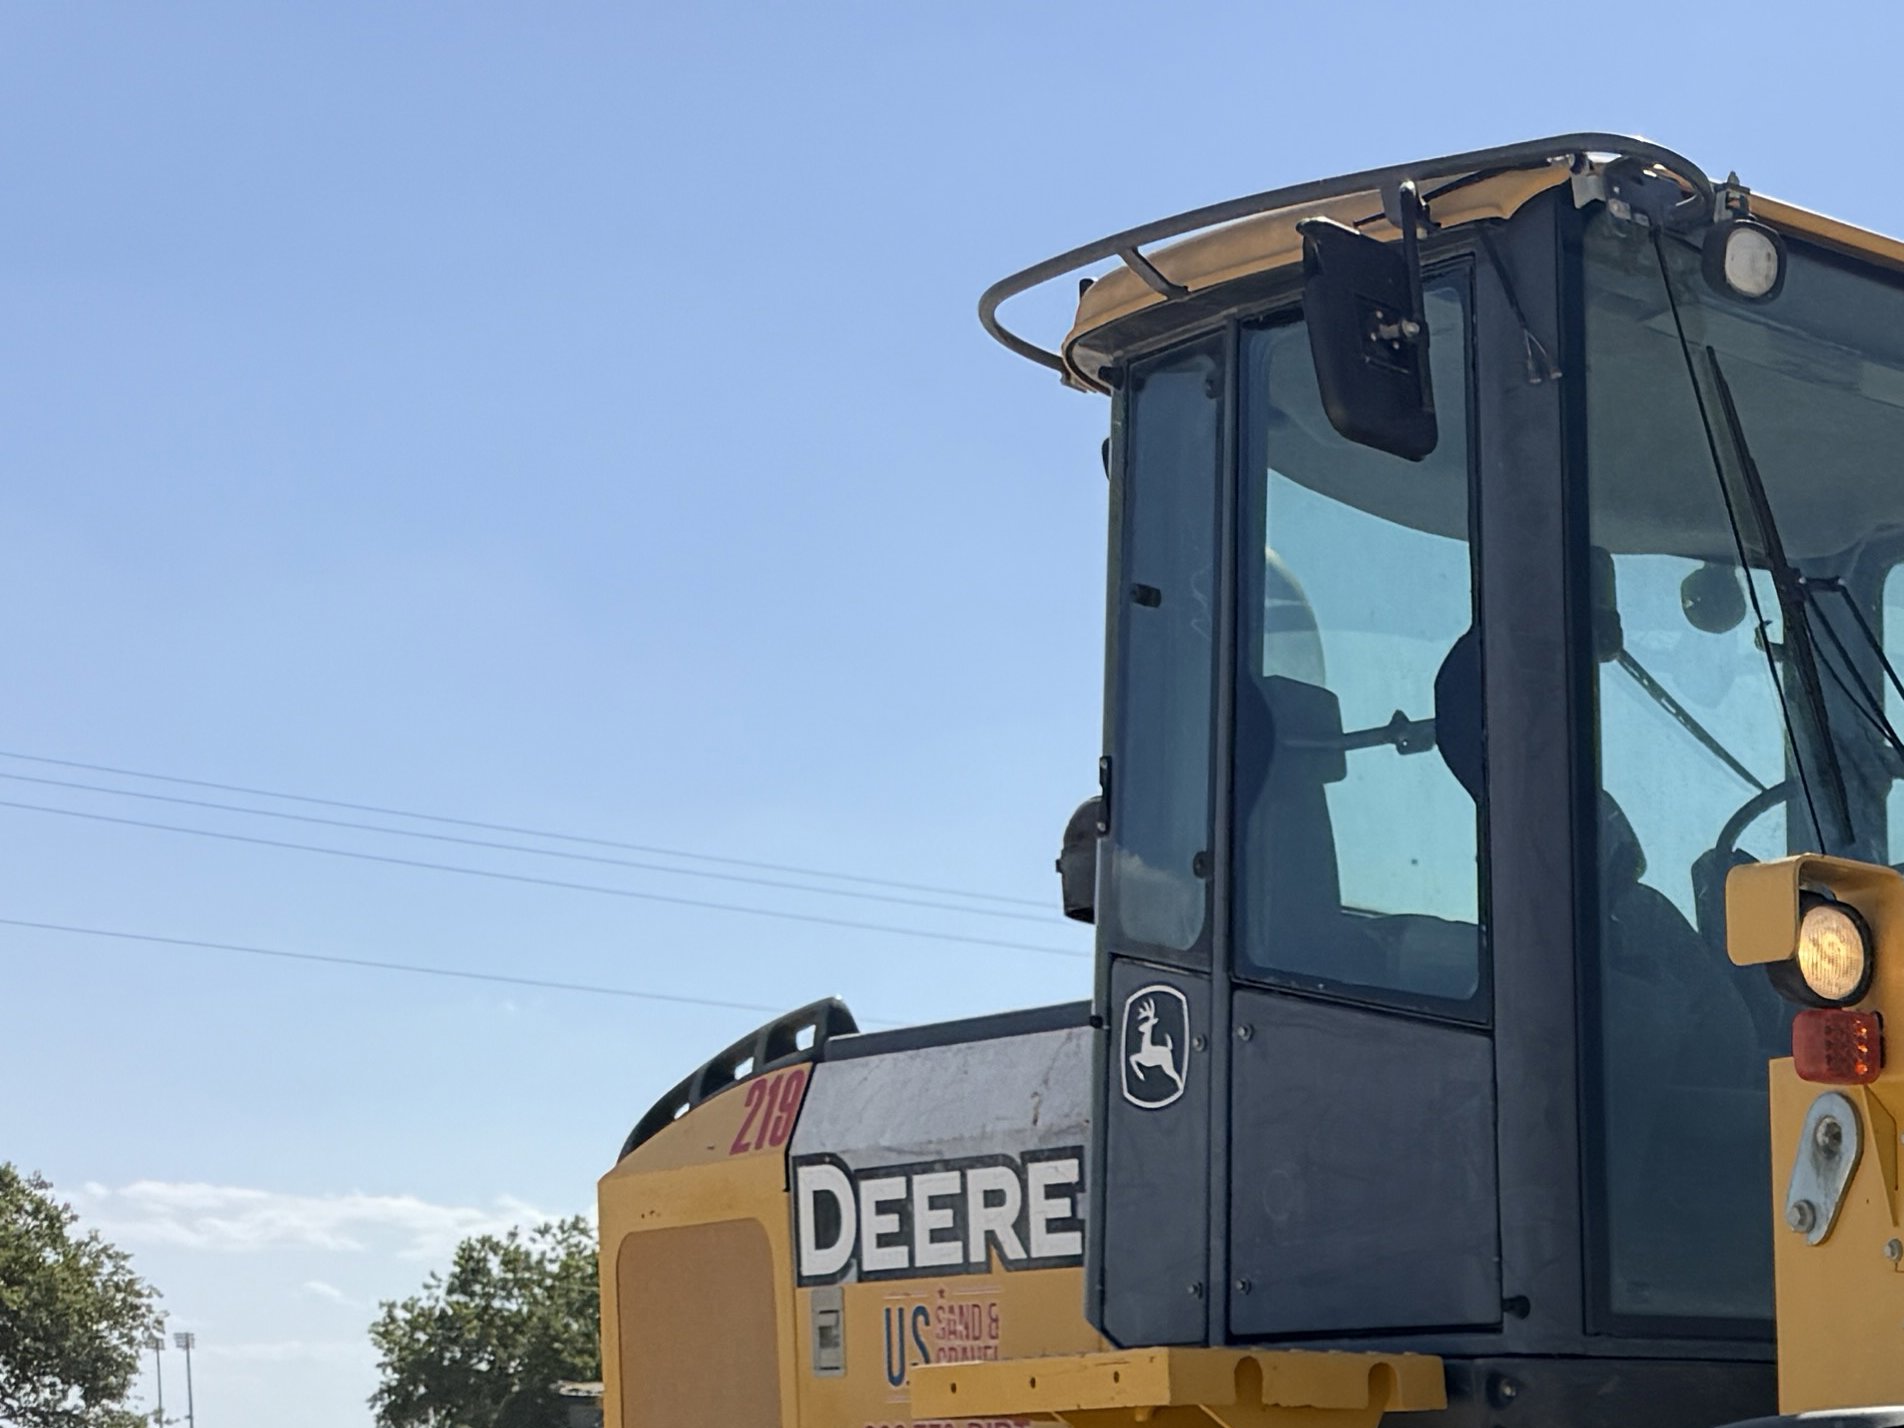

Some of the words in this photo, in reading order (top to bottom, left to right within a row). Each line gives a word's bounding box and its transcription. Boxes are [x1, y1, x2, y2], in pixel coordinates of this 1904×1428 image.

[729, 1070, 805, 1155] 219
[797, 1158, 1083, 1277] DEERE
[935, 1304, 982, 1340] SAND
[988, 1303, 999, 1340] &
